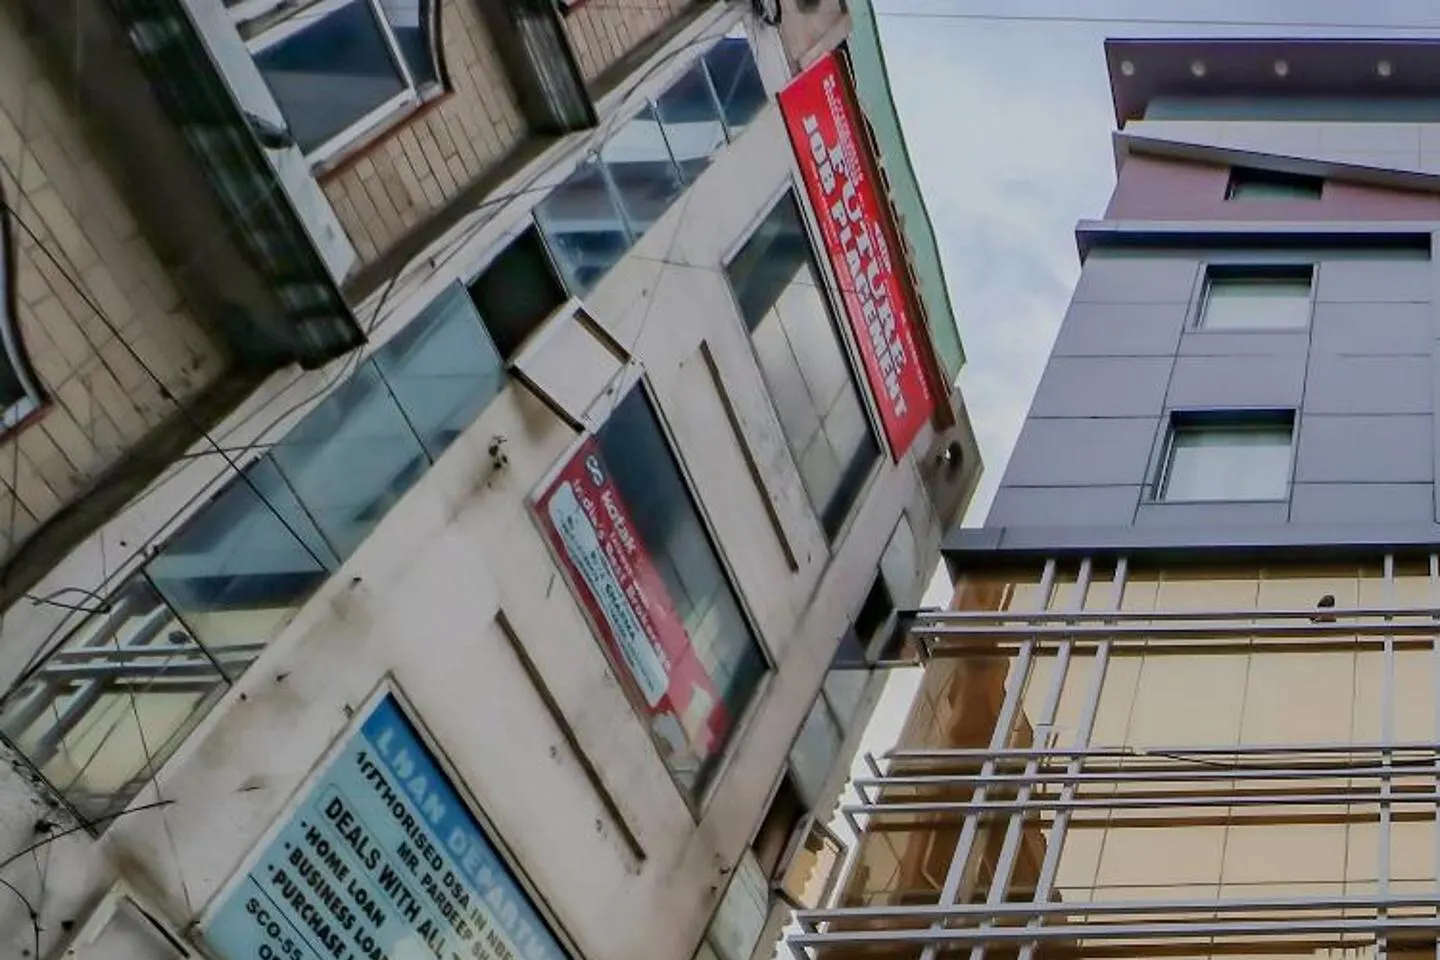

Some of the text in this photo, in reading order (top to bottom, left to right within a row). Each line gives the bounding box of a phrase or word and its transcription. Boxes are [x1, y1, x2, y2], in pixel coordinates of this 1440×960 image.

[802, 110, 836, 197] JOB
[829, 198, 907, 422] PLACEMENT
[826, 137, 907, 377] FUTURE
[599, 487, 637, 556] kotak
[272, 869, 345, 958] PURCHASE
[289, 847, 355, 929] BUSINESS
[305, 826, 385, 927] HOME LOAN
[325, 797, 380, 869] DEALS
[378, 864, 420, 922] WITH
[416, 919, 445, 960] ALL
[396, 841, 419, 876] MR.
[420, 873, 472, 939] PARDEEP
[442, 870, 469, 909] DSA
[469, 907, 487, 931] IN
